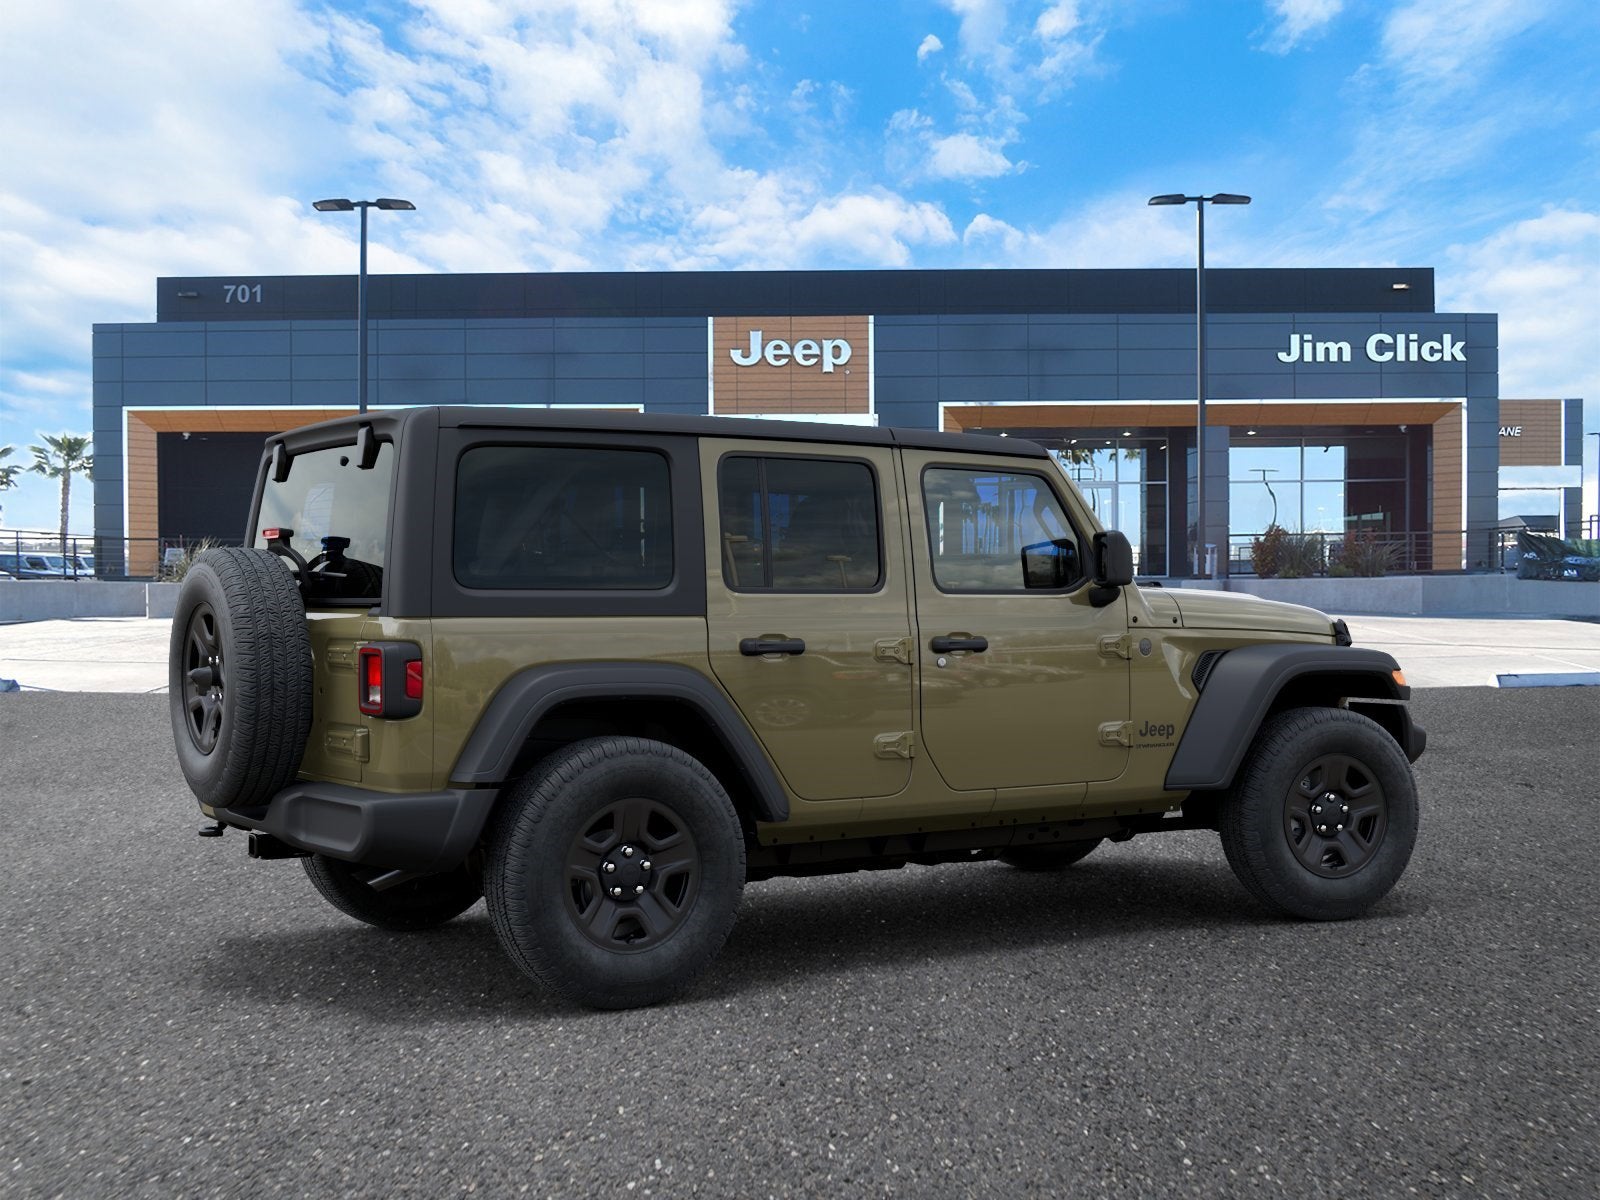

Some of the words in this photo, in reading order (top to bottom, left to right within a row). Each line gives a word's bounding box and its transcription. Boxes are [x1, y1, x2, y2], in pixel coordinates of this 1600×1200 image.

[223, 284, 262, 304] 701
[729, 330, 852, 373] Jeep
[1277, 333, 1351, 363] Jim
[1365, 333, 1467, 363] Click
[1139, 720, 1175, 740] Jeep
